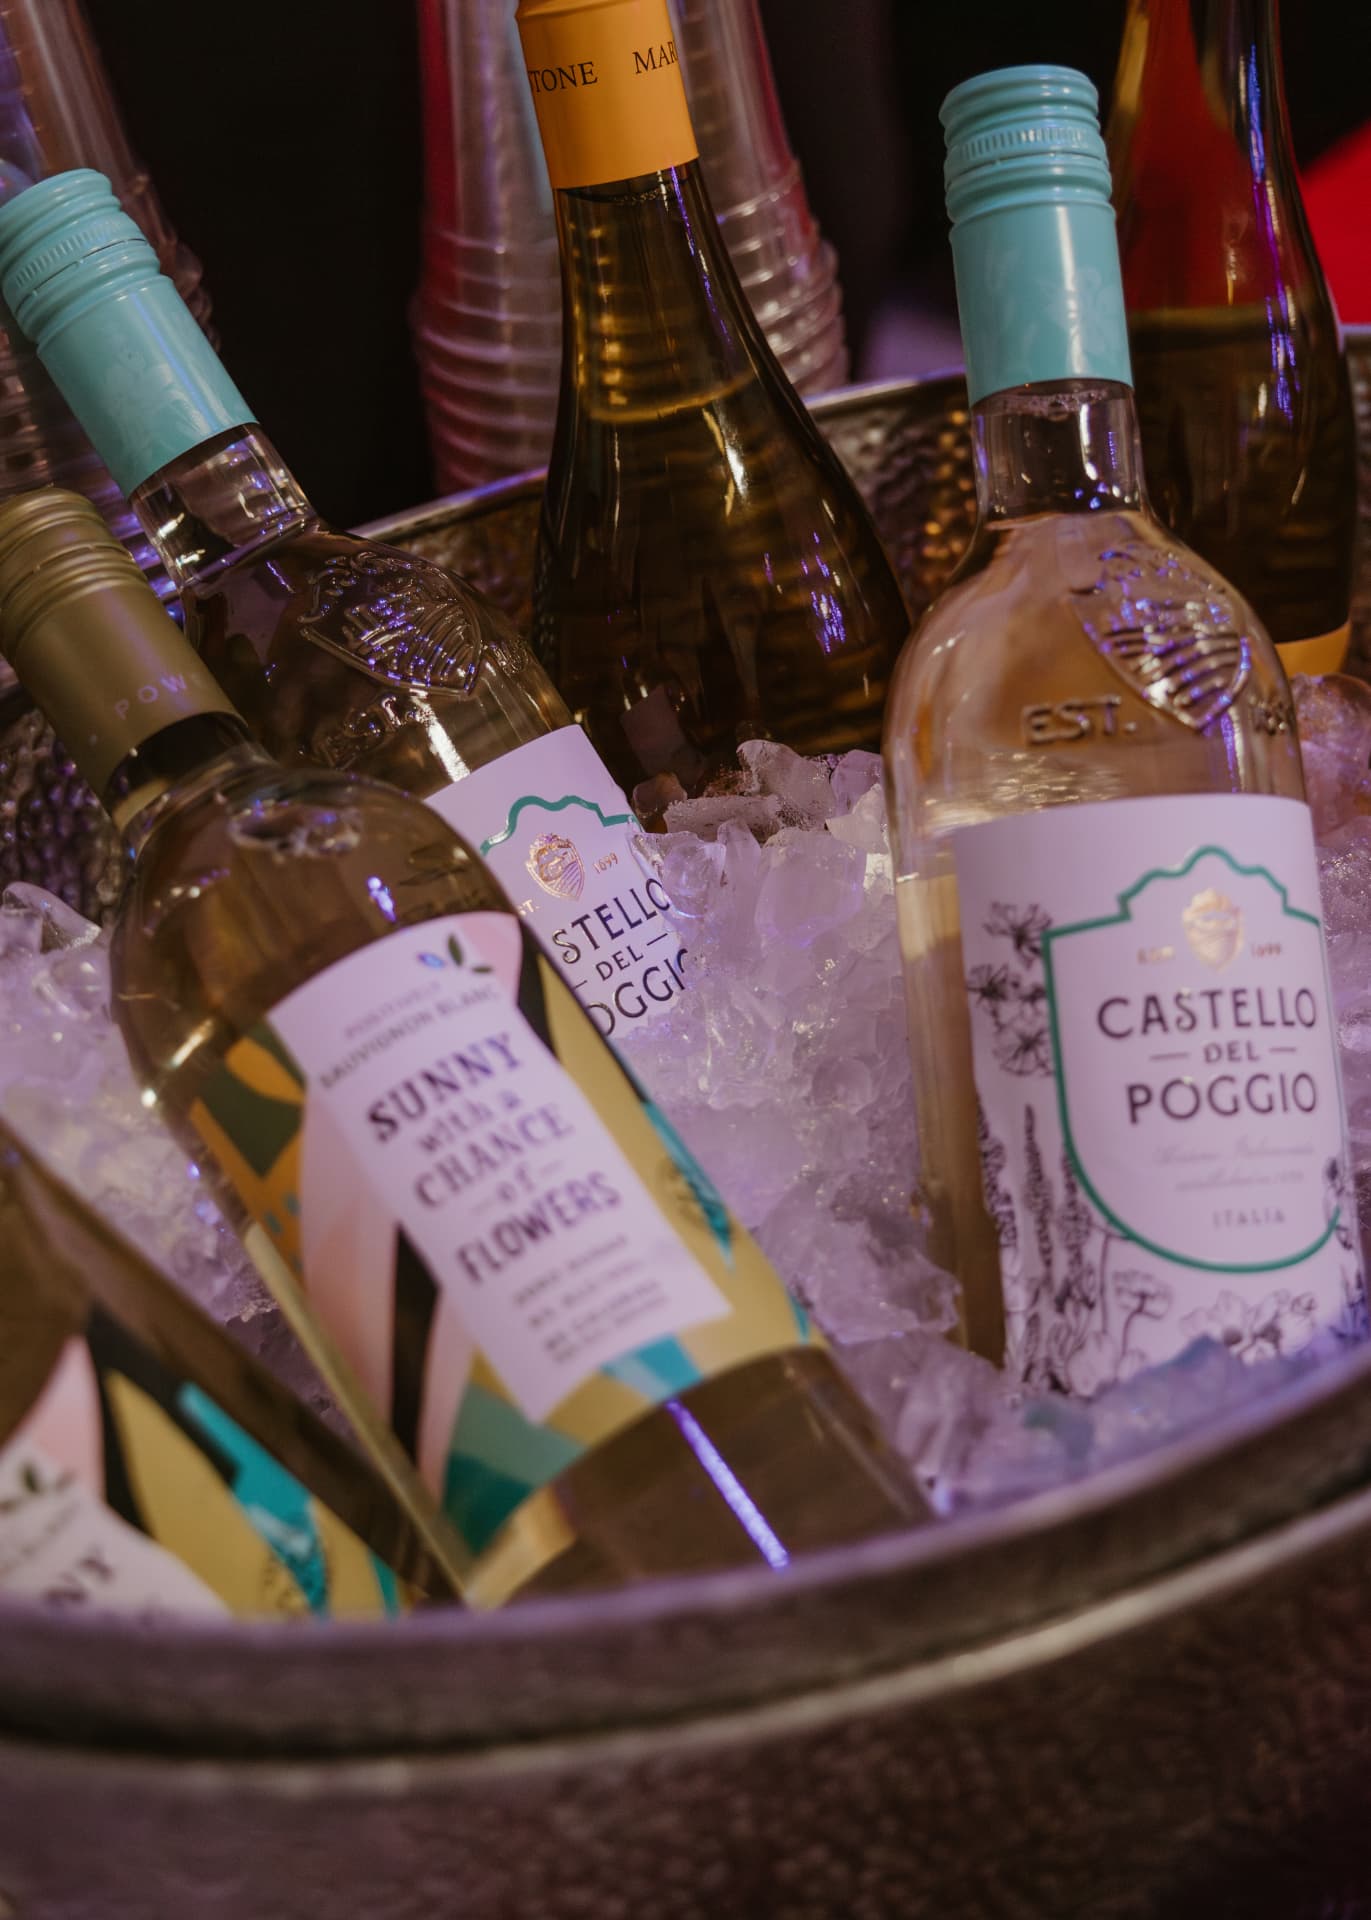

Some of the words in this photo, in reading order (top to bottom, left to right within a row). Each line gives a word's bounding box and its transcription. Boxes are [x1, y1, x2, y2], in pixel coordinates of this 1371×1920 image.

[595, 945, 644, 981] DEL
[1097, 987, 1317, 1039] CASTELLO
[1203, 1041, 1260, 1064] DEL
[367, 1032, 521, 1142] SUNNY
[1126, 1073, 1317, 1125] POGGIO
[414, 1103, 574, 1208] CHANCE
[456, 1172, 621, 1284] FLOWERS
[1212, 1208, 1286, 1230] ITALIA
